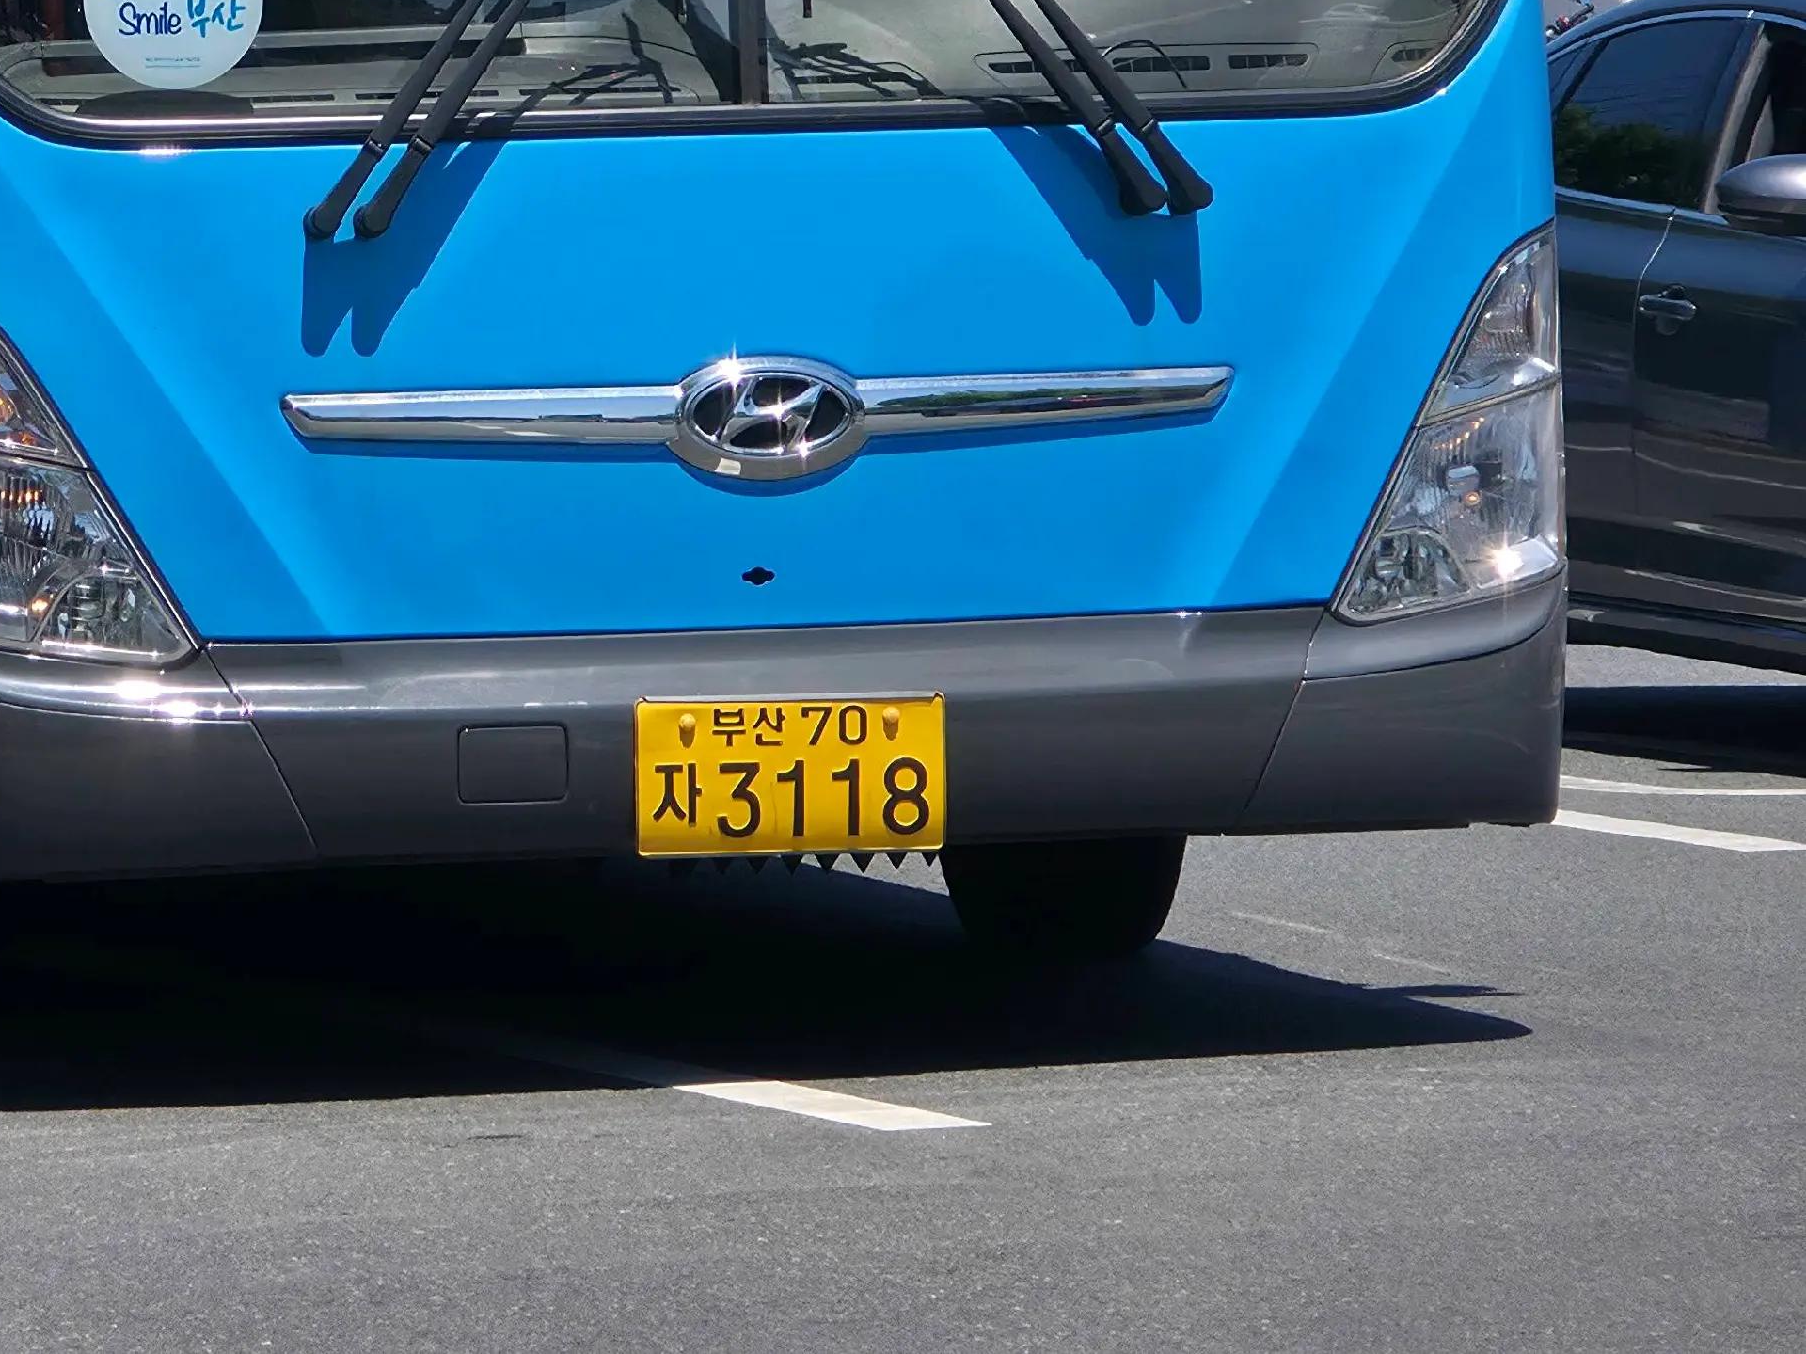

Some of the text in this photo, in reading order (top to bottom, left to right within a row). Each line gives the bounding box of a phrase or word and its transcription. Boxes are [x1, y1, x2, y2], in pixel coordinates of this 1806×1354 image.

[118, 2, 182, 36] Smile
[711, 705, 868, 747] 부산 70
